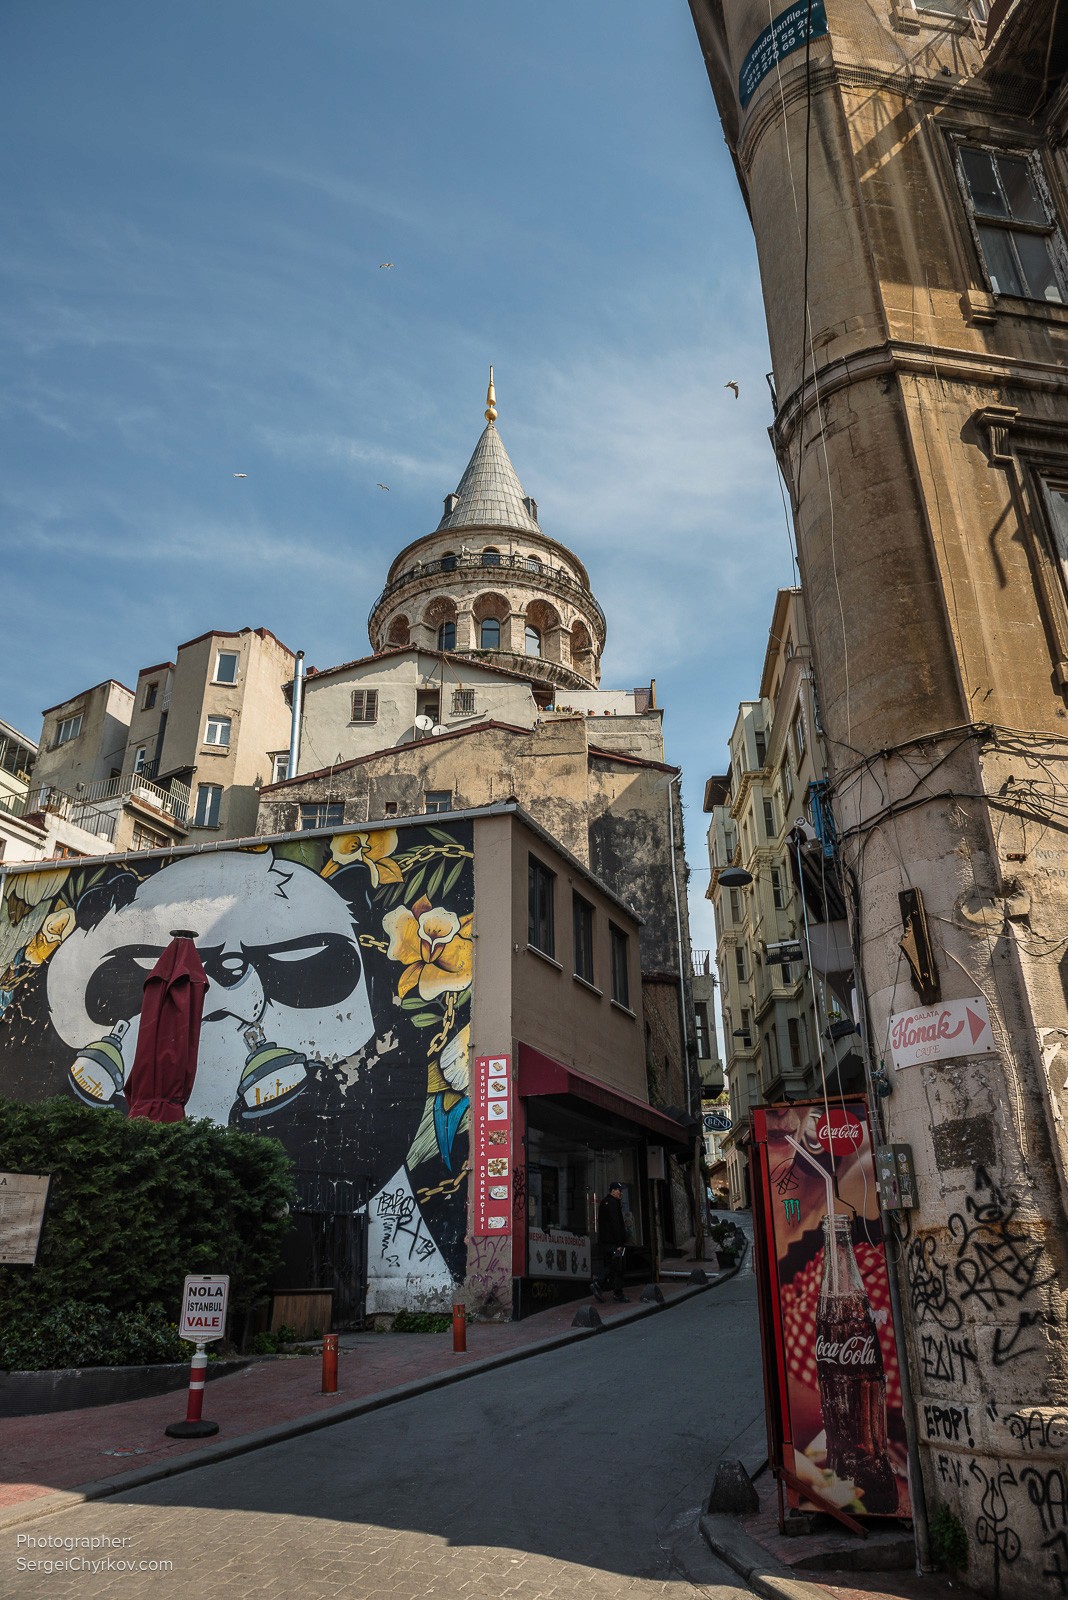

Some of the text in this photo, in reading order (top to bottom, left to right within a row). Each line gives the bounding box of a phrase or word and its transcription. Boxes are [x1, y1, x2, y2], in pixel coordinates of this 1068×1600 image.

[781, 27, 795, 42] 55
[762, 50, 779, 72] 270
[782, 37, 795, 51] 69
[914, 1010, 939, 1021] GALATA
[892, 1010, 965, 1050] Konak
[916, 1045, 940, 1058] CAFE
[819, 1124, 860, 1139] Coca-Cola
[188, 1287, 223, 1297] NOLA
[187, 1300, 222, 1312] İSTANBUL
[187, 1317, 219, 1327] VALE
[816, 1335, 876, 1365] Coca-Cola
